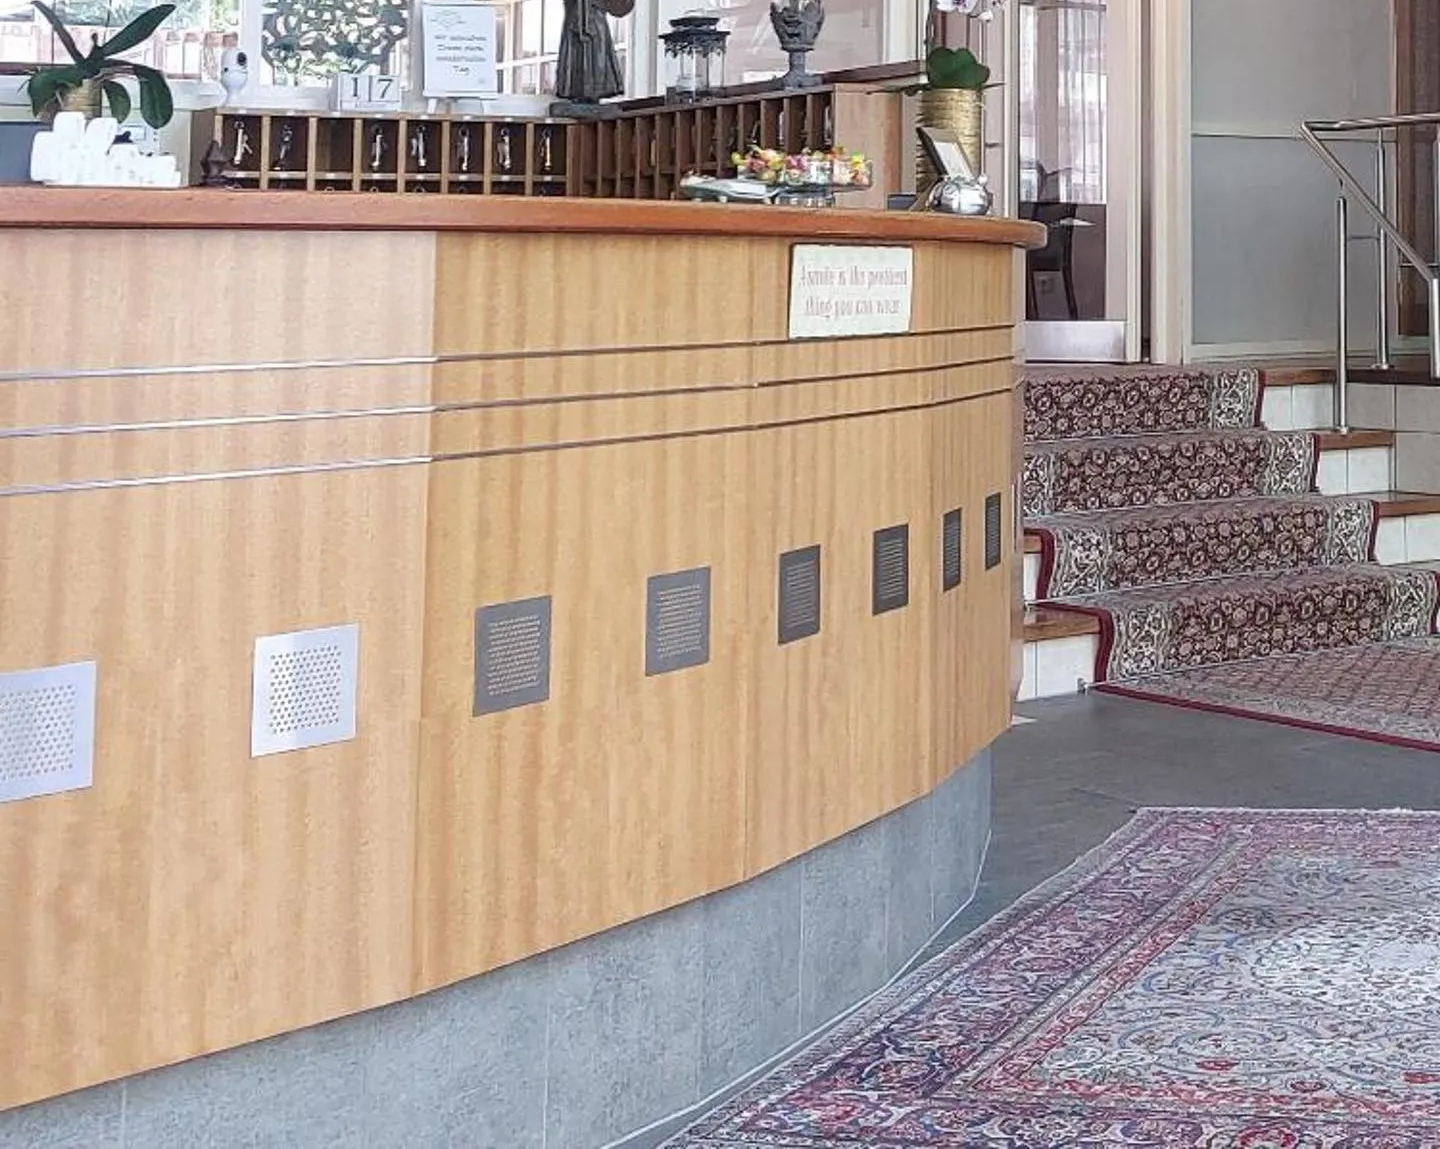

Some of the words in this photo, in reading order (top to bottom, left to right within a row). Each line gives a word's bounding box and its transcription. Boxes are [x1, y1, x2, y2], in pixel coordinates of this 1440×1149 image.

[808, 266, 834, 286] smile
[838, 267, 847, 286] is
[850, 265, 865, 286] the
[805, 296, 832, 319] thing
[834, 299, 854, 319] you
[856, 298, 873, 315] can
